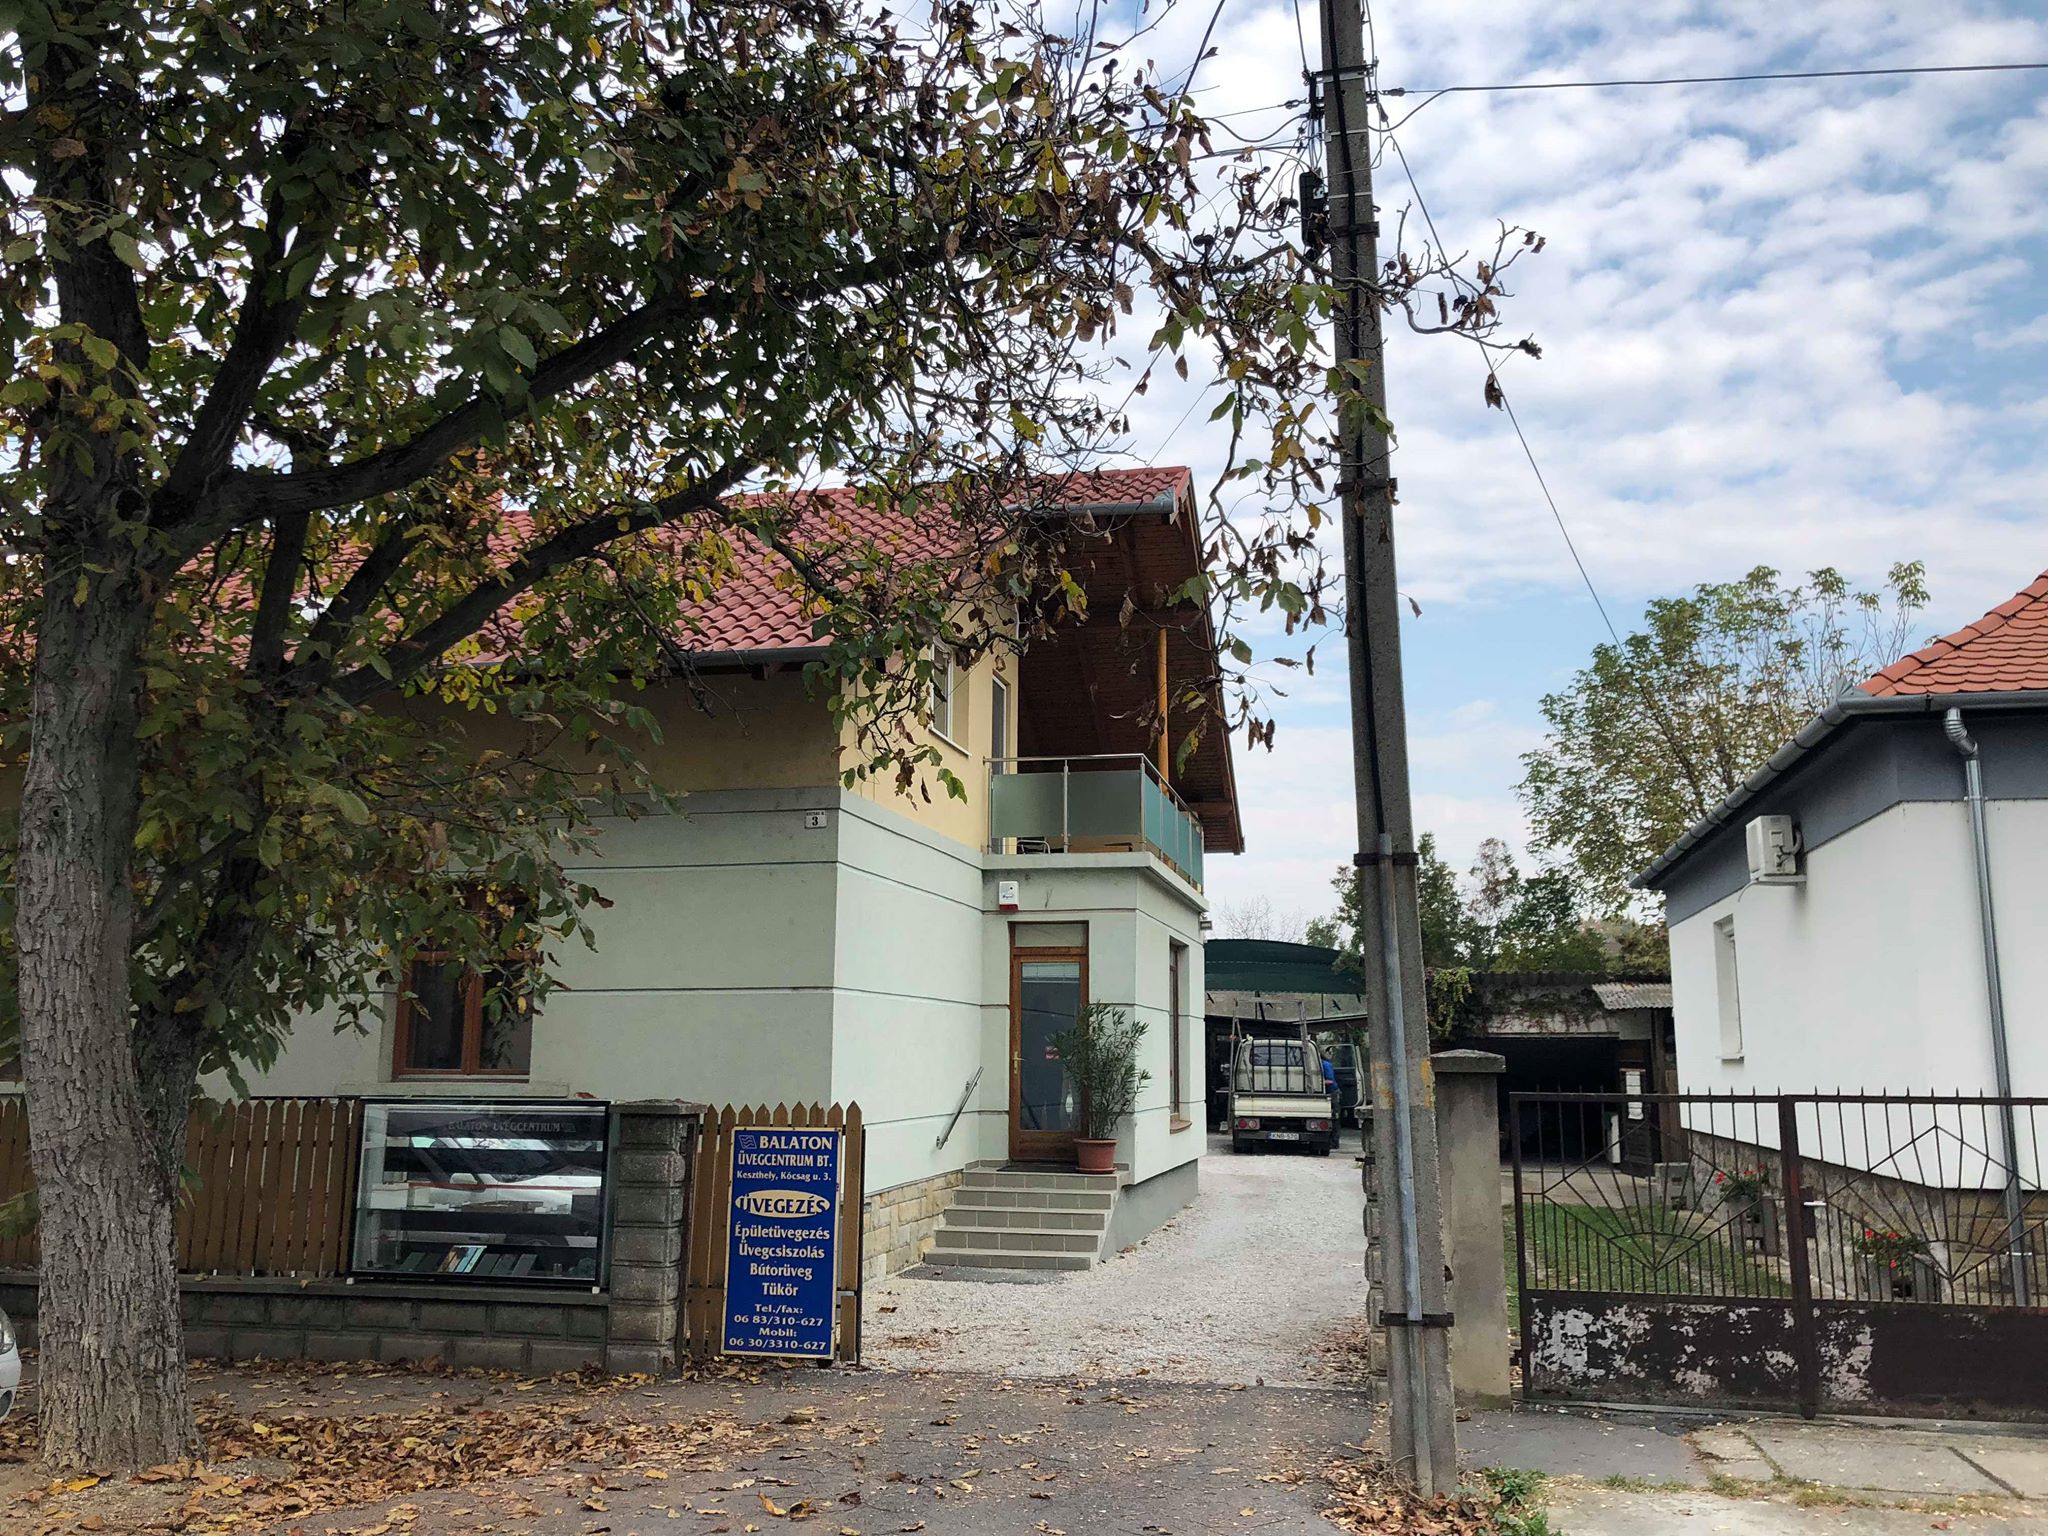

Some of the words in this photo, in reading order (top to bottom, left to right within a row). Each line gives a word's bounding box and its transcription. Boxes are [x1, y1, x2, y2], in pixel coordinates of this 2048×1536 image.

[811, 816, 819, 826] 3
[760, 1136, 832, 1150] BALATON
[738, 1150, 814, 1167] ÜVEGCENTRUM
[816, 1154, 833, 1167] BT.
[736, 1170, 779, 1181] Keszthely,
[780, 1171, 811, 1182] Kócsag
[823, 1172, 832, 1181] 3.
[739, 1194, 826, 1214] ÜVEGEZÉS
[735, 1221, 830, 1242] Épületüvegezés
[739, 1239, 825, 1259] Üvegcsiszolás
[750, 1263, 813, 1280] Bútorüveg
[761, 1282, 799, 1296] Tükör
[755, 1304, 803, 1314] Tel./fax:
[733, 1314, 749, 1324] 06
[752, 1315, 824, 1327] 83/310-627
[758, 1327, 798, 1338] Mobil:
[728, 1337, 745, 1347] 06
[748, 1337, 827, 1351] 30/3310-627
